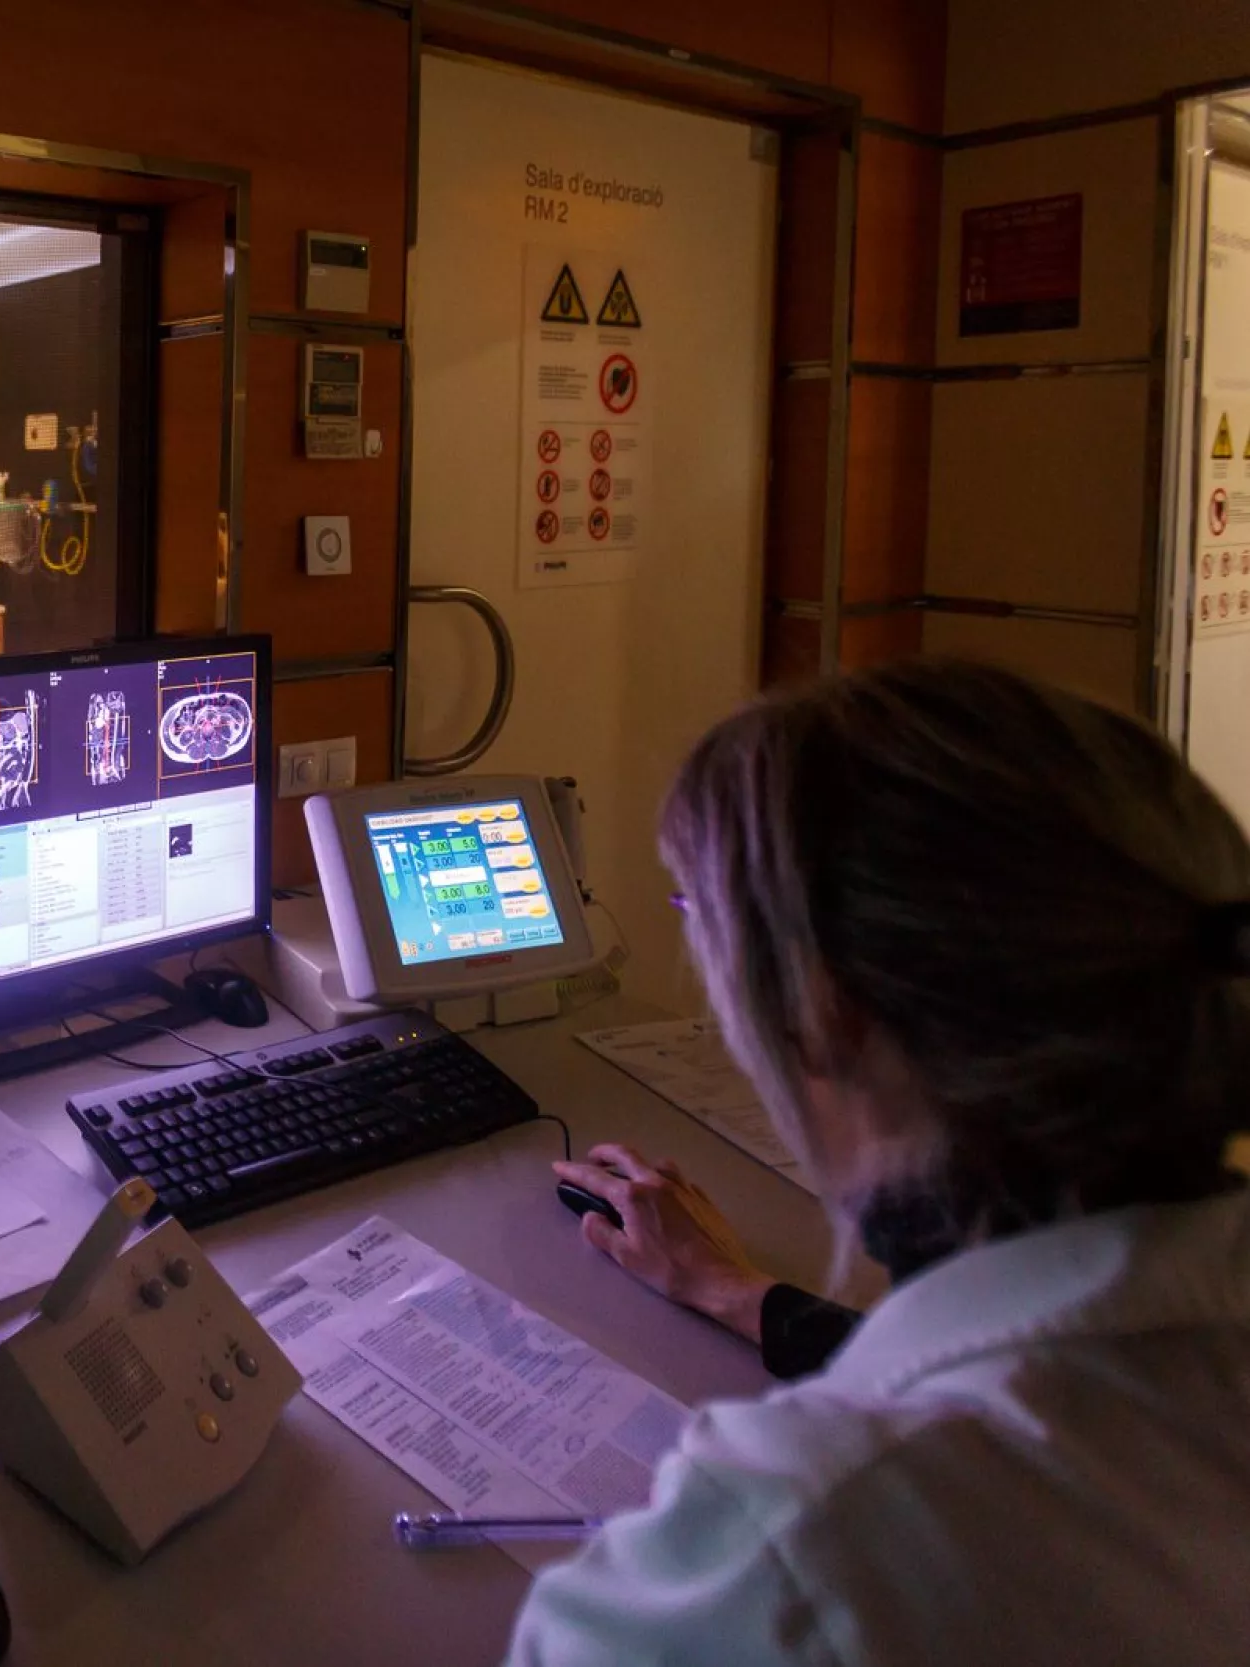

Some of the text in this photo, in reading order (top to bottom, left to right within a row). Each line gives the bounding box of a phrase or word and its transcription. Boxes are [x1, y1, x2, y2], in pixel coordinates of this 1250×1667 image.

[526, 162, 664, 208] Sala d'exploració
[524, 195, 569, 223] RM 2
